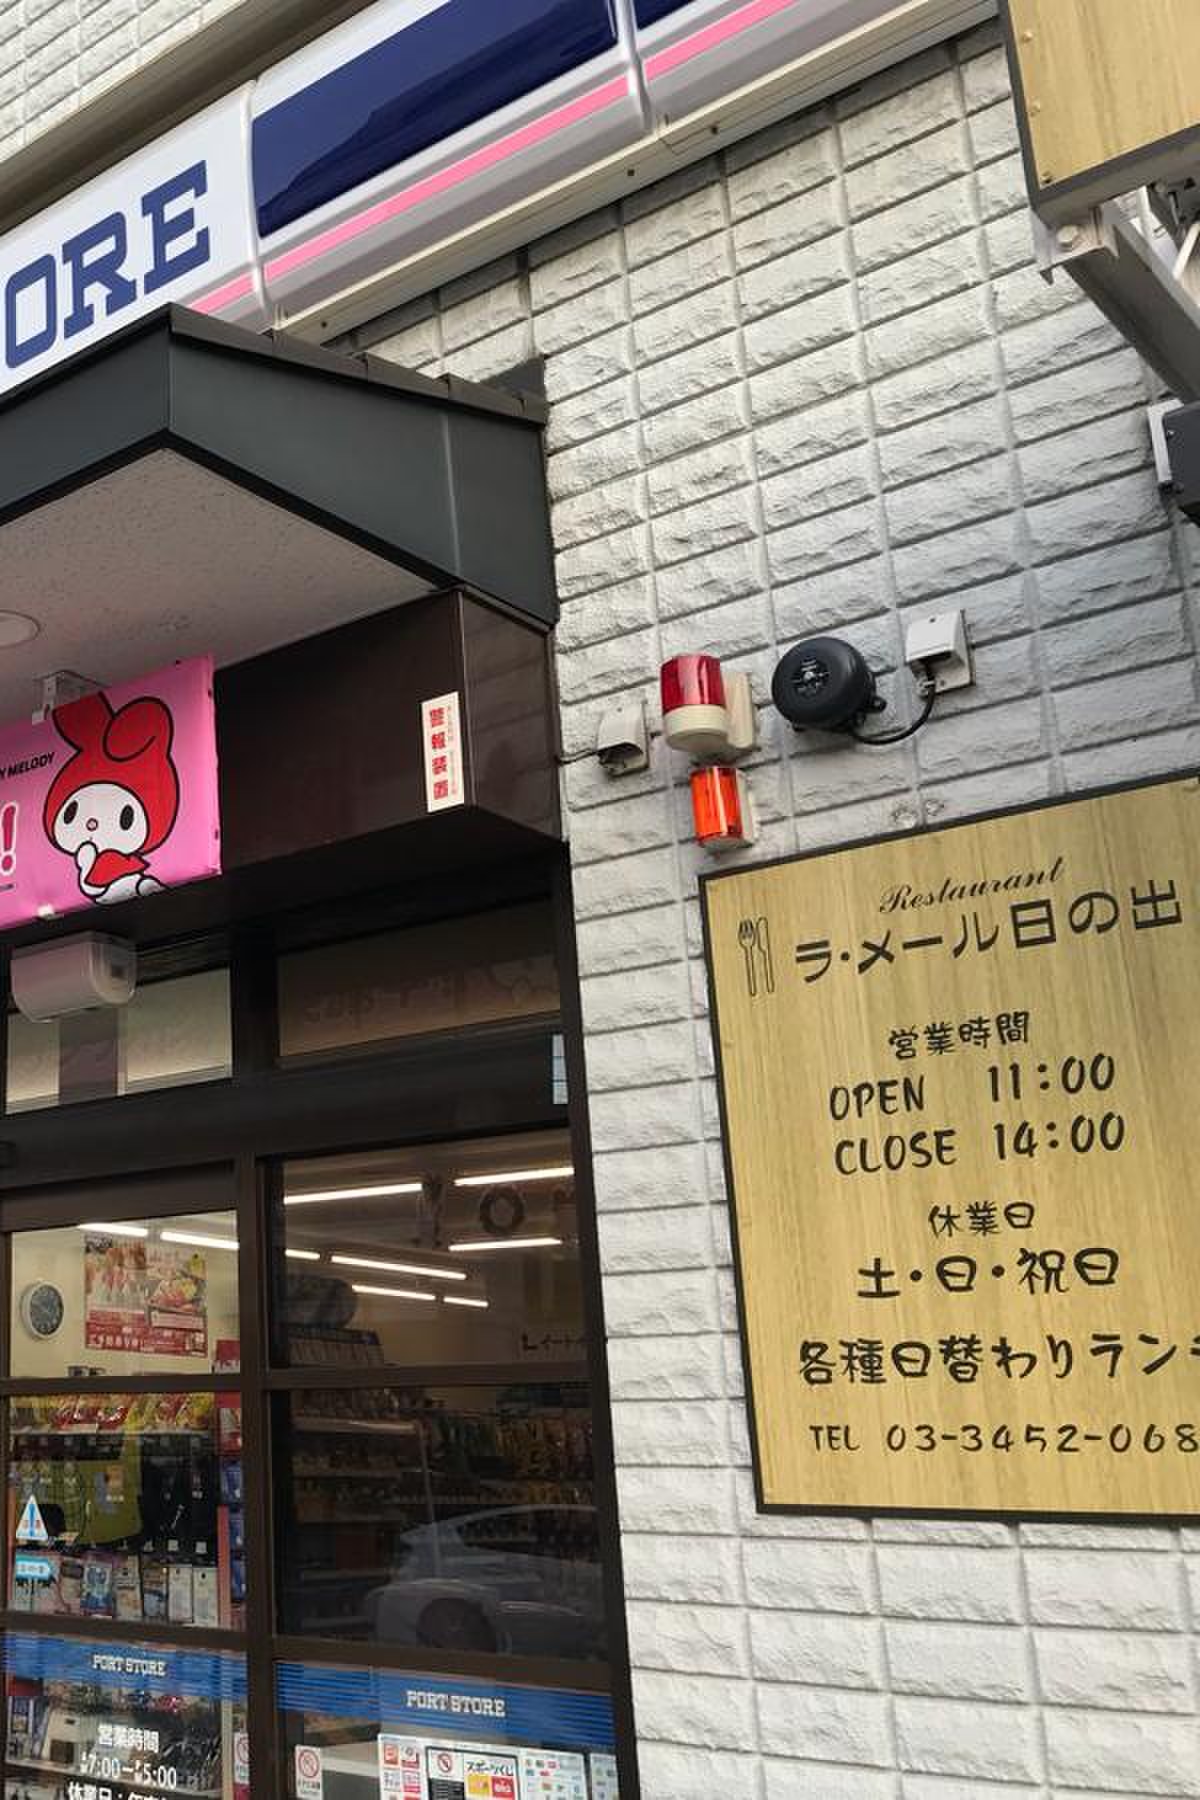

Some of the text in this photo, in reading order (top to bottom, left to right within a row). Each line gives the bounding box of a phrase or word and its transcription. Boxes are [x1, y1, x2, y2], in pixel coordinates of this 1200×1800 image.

[8, 752, 55, 777] MELODY
[878, 858, 1070, 914] Restaurant
[795, 879, 1184, 983] ラ・メール日の出
[888, 1011, 1031, 1060] 営業時間
[829, 1053, 1116, 1121] OPEN 11:00
[834, 1113, 1126, 1175] CLOSE 14:00
[928, 1201, 1036, 1237] 休業日
[857, 1247, 1120, 1299] 土・日・祝日
[799, 1334, 1200, 1386] 各種日替わりラン
[809, 1423, 1199, 1455] TEL 03-3452-068
[92, 1654, 166, 1676] PORT STORE
[406, 1690, 506, 1717] PORT STORE
[98, 1724, 159, 1753] 営業時間
